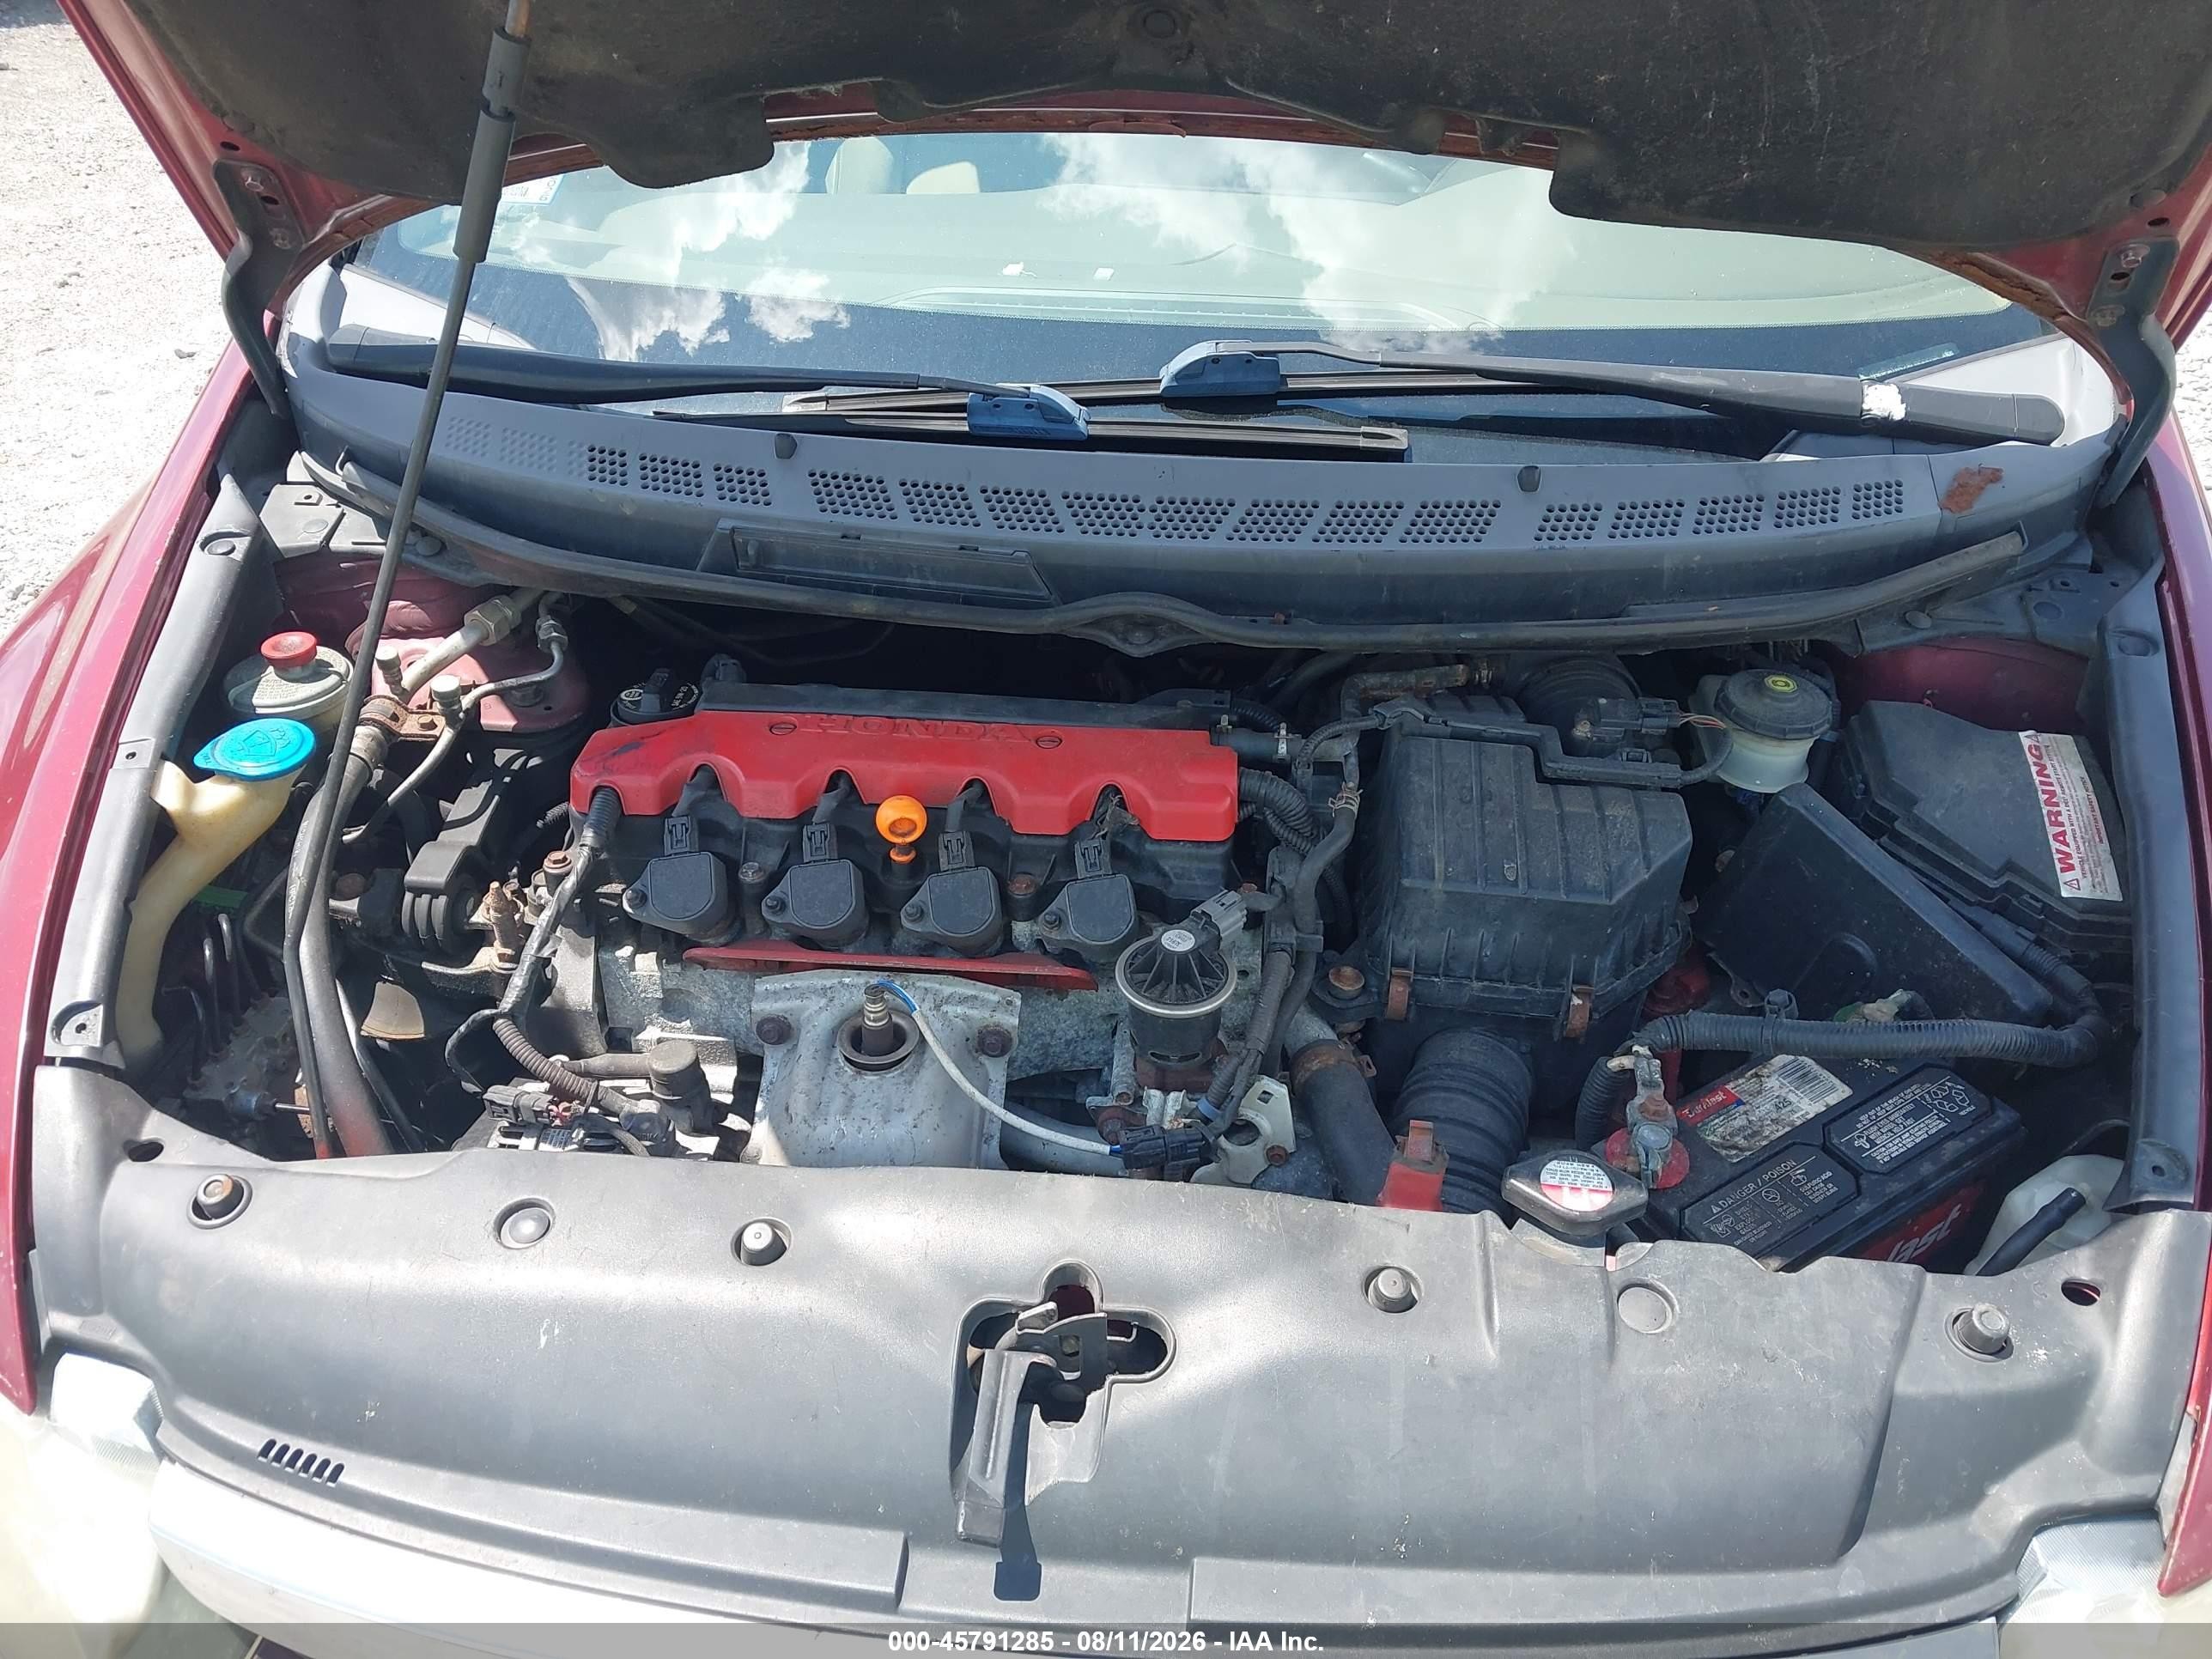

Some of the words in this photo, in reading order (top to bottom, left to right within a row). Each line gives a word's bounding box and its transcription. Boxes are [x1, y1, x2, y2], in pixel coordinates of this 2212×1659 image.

[798, 714, 1032, 743] HONDA
[2028, 744, 2075, 873] WARNING
[2087, 794, 2096, 811] SAFETY
[2071, 830, 2081, 854] EQUIPPED
[2093, 814, 2103, 843] IMPORTANT
[2077, 857, 2087, 877] VEHICLE
[1864, 1126, 1880, 1135] FLUSH
[1877, 1118, 1890, 1127] EYES
[1889, 1105, 1915, 1121] IMMEDIATELY
[1875, 1133, 1893, 1144] MEDICAL
[1902, 1117, 1915, 1127] FAST
[1869, 1131, 1882, 1139] WITH
[1719, 1182, 1758, 1208] DANGER
[1765, 1159, 1797, 1182] POISON
[1889, 1204, 1963, 1263] last
